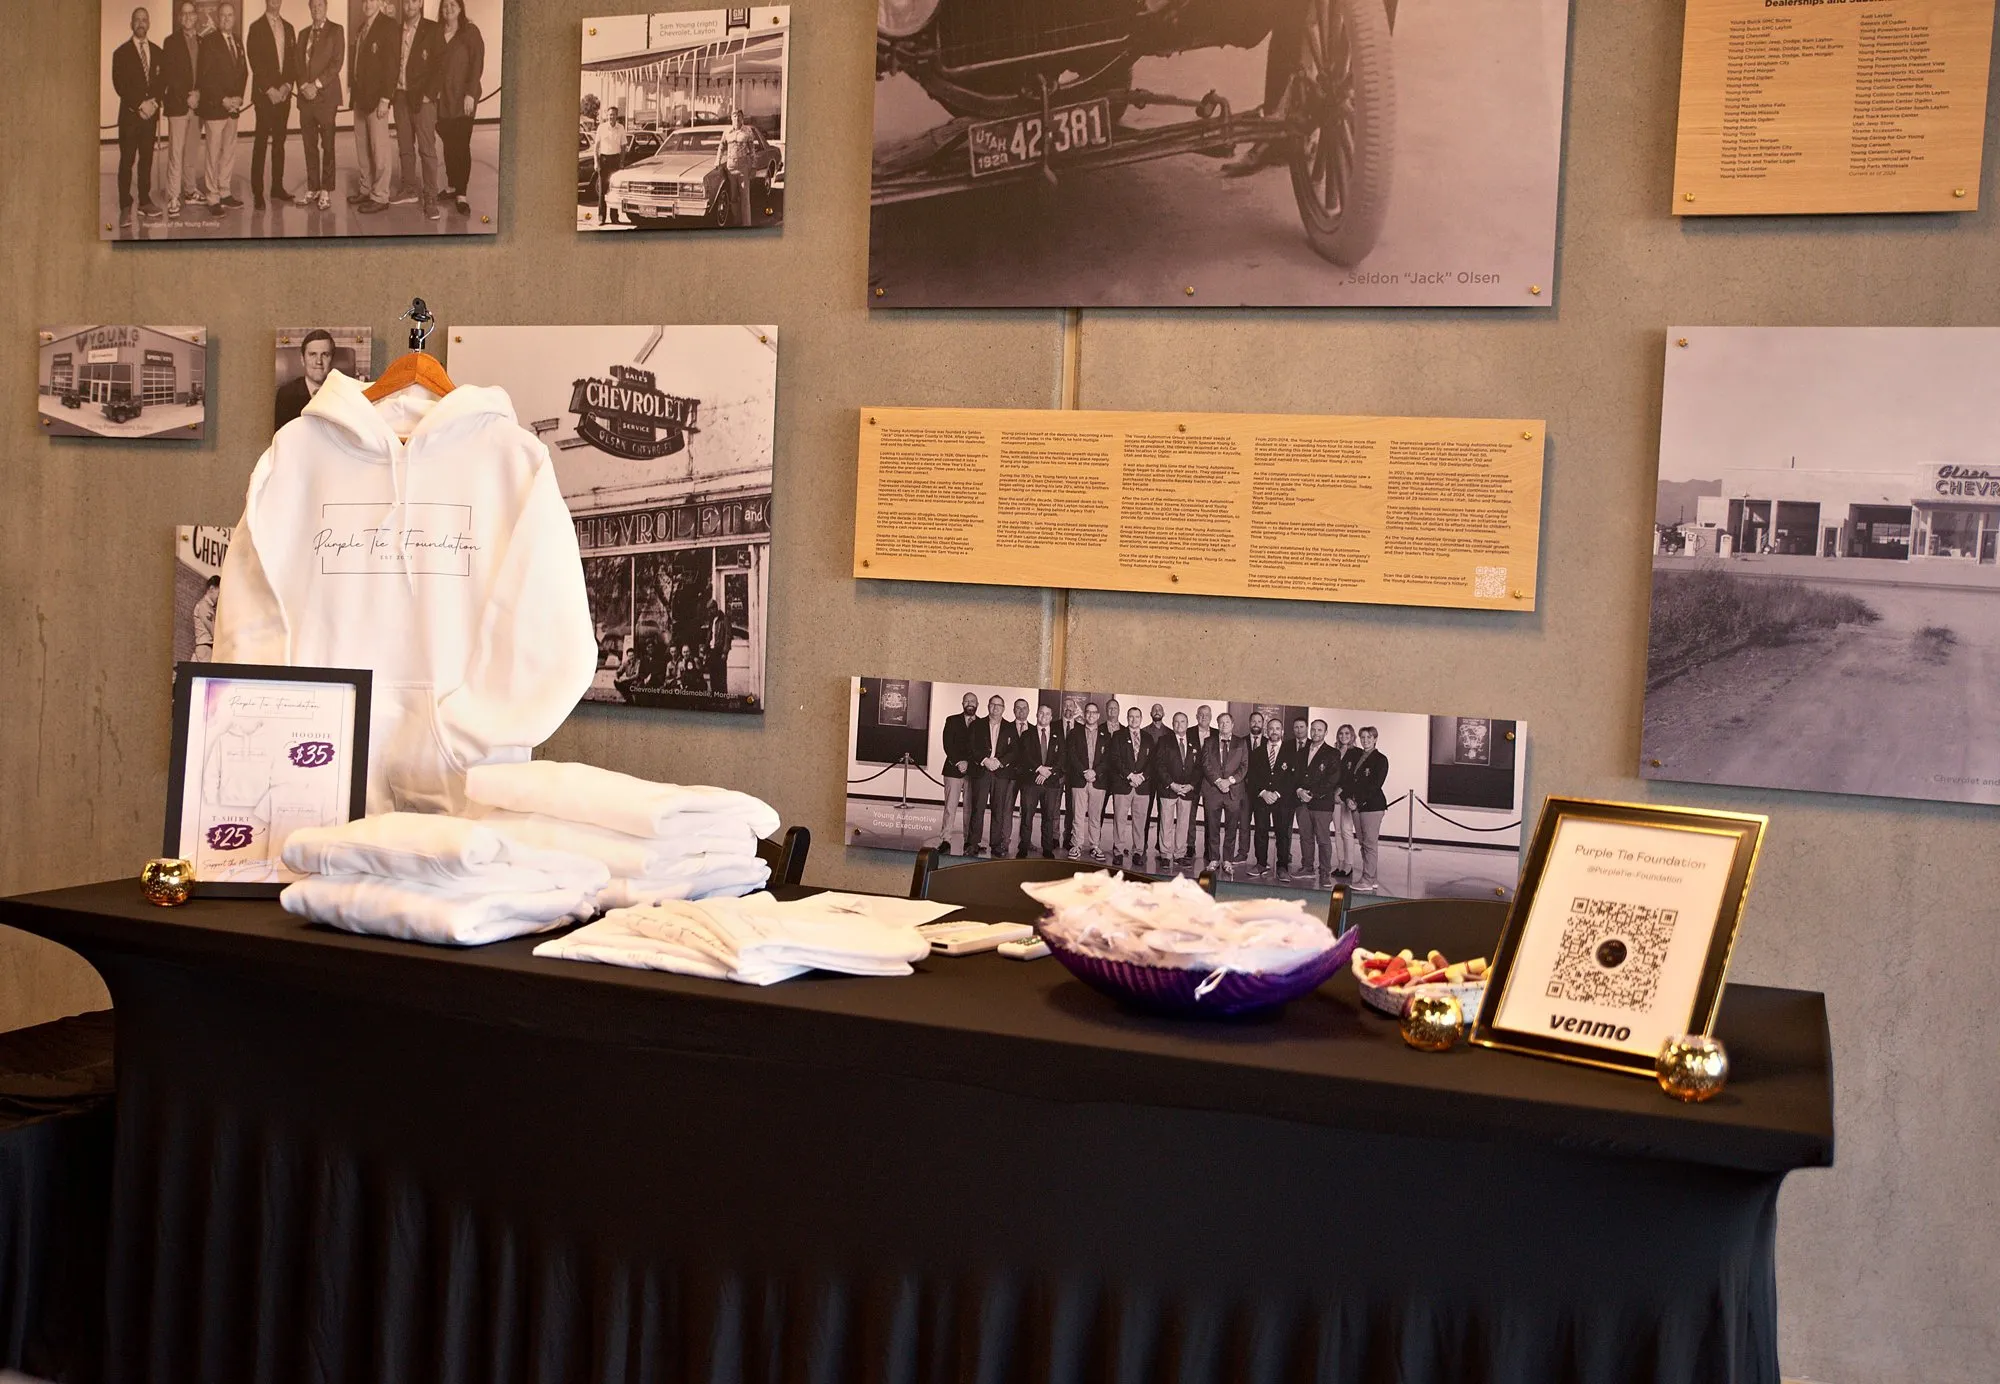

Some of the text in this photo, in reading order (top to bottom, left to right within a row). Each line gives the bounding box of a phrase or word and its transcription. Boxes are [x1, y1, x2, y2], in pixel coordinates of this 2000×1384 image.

[976, 106, 1106, 160] UTAH 42 381
[1348, 271, 1398, 284] Seldon
[1457, 271, 1500, 284] Olsen
[89, 327, 140, 344] YOUNG
[625, 373, 648, 383] SALES
[586, 382, 684, 422] CHEVROLET
[623, 423, 649, 433] SERVICE
[600, 430, 626, 450] OLSEN
[577, 502, 762, 548] HEVROLET and
[313, 528, 481, 556] Purple Tie Foundation
[630, 686, 660, 694] Chevrolet
[714, 691, 738, 699] Morgan
[294, 744, 329, 765] $35
[873, 820, 932, 831] Group Executives
[874, 811, 936, 823] Young Automotive
[212, 827, 246, 847] $25
[1575, 844, 1706, 870] Purple Tie Foundation
[1549, 1014, 1632, 1041] venmo
